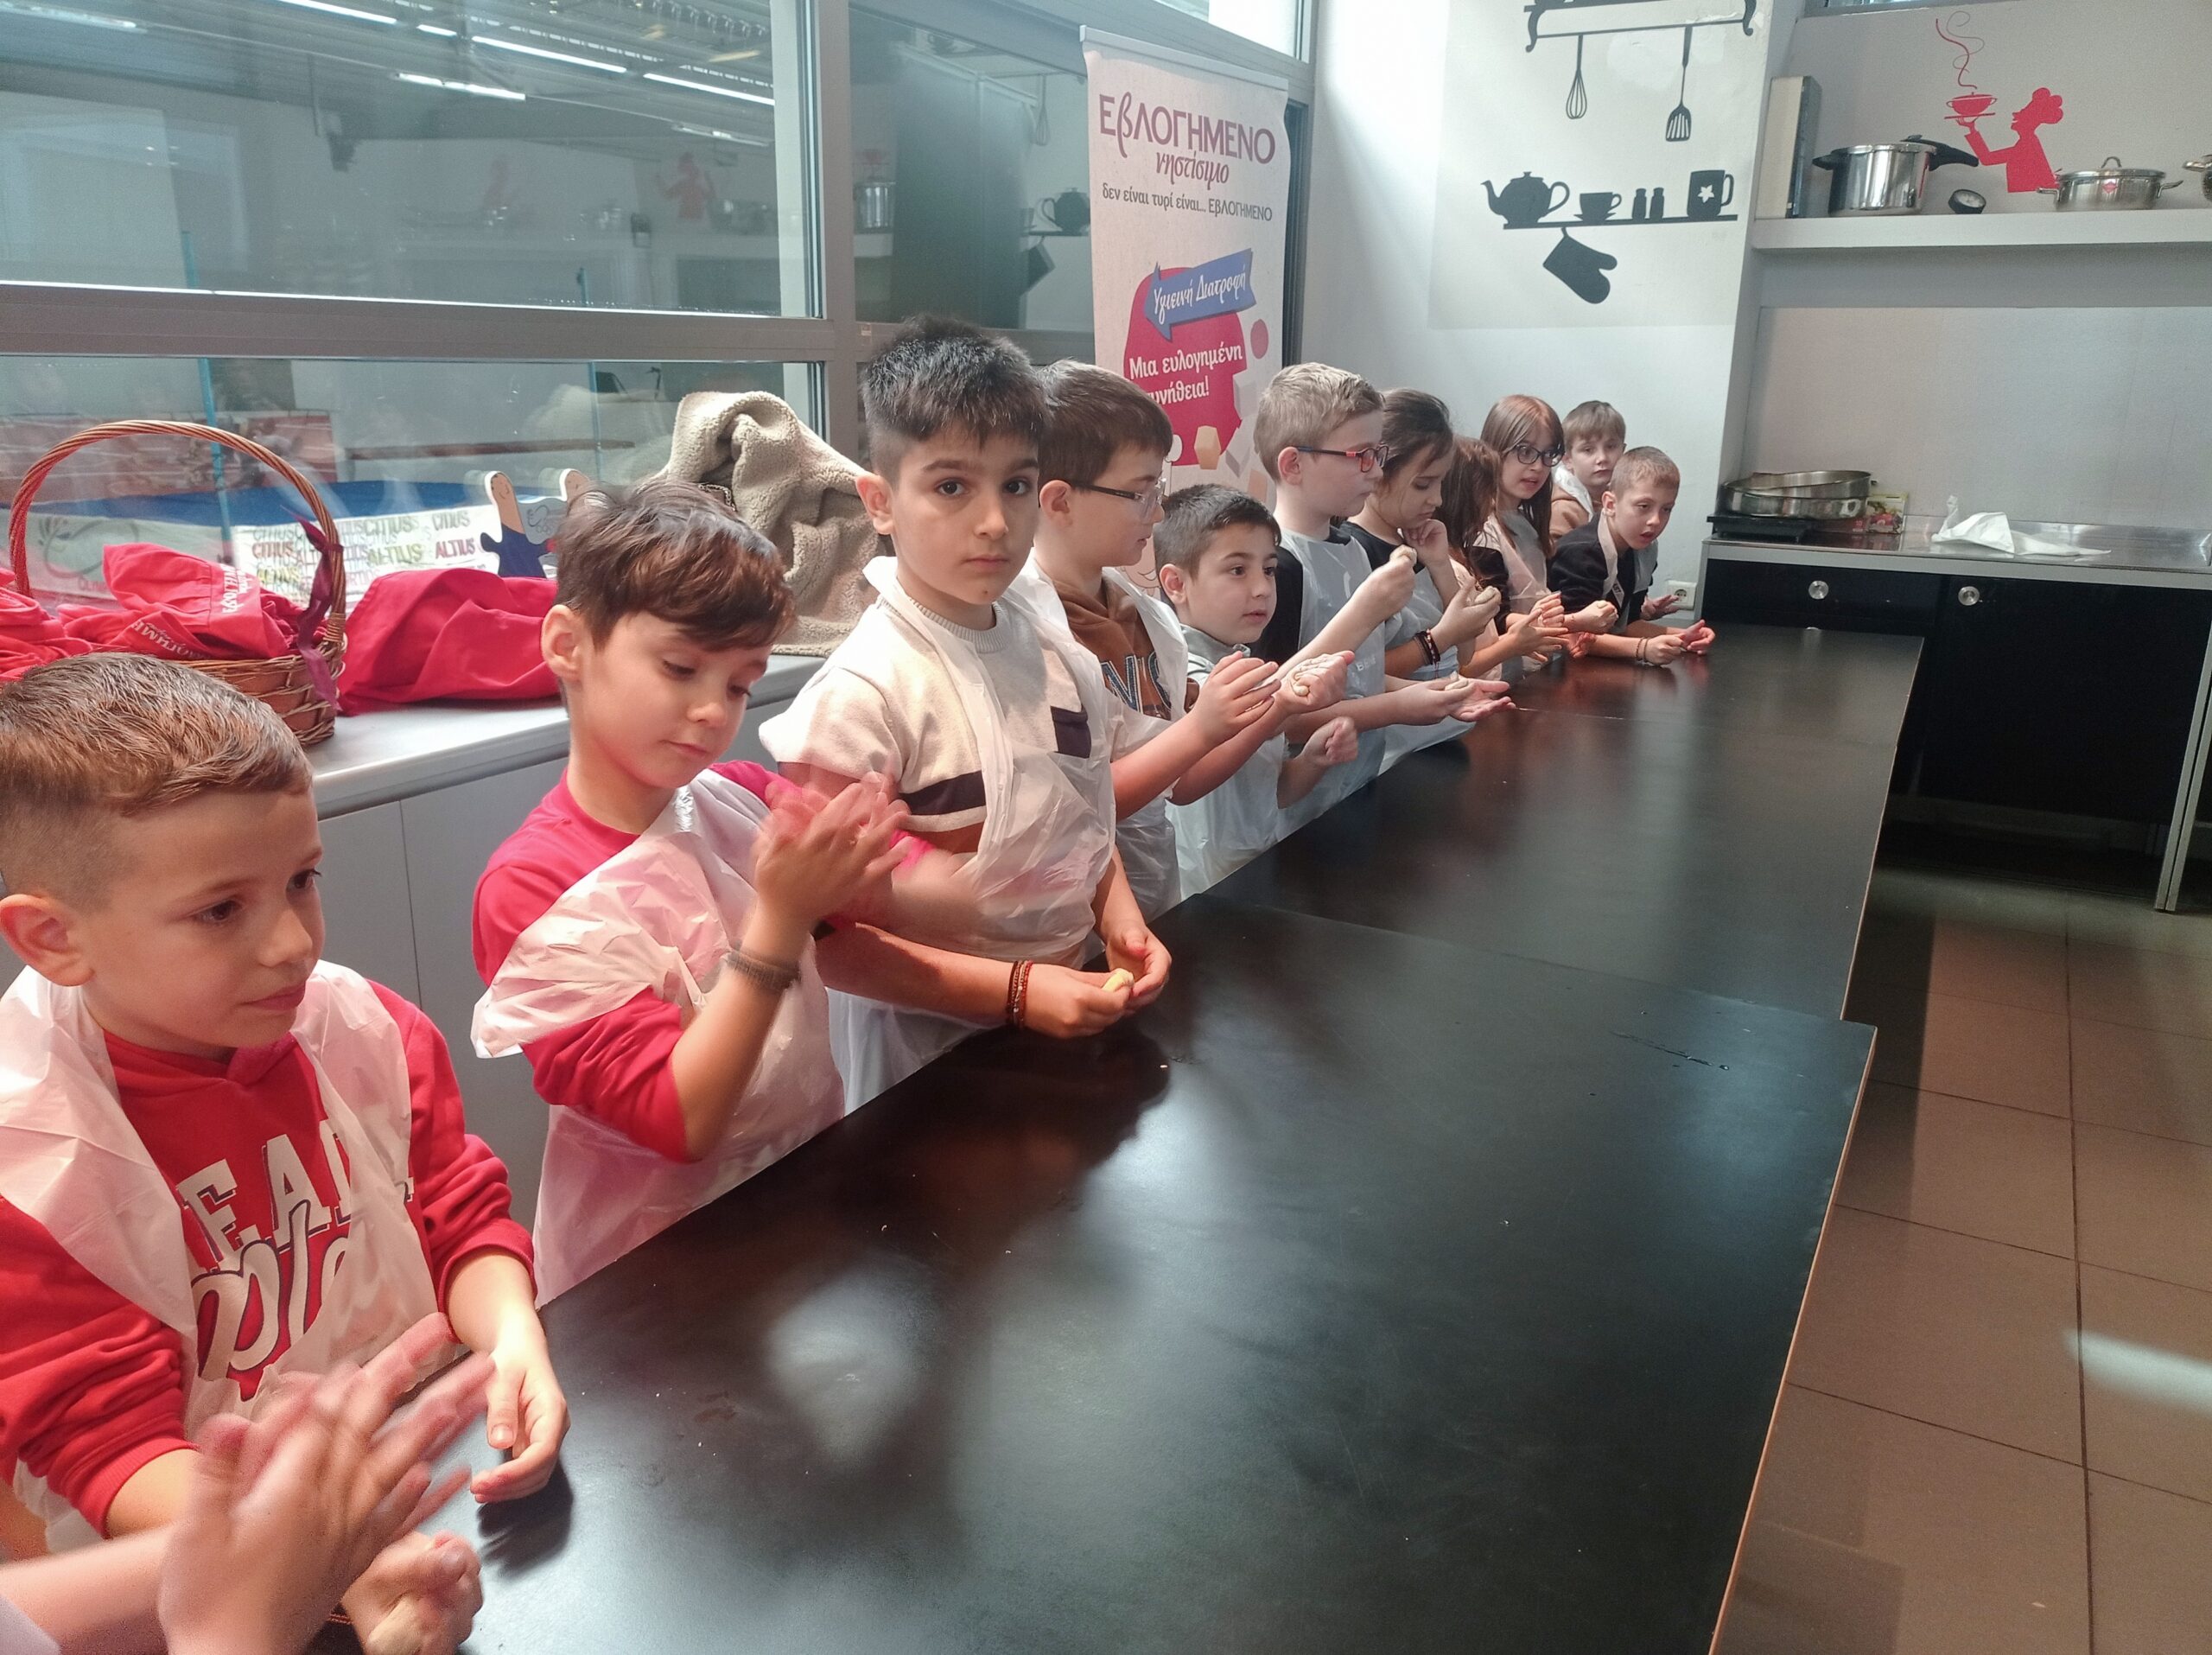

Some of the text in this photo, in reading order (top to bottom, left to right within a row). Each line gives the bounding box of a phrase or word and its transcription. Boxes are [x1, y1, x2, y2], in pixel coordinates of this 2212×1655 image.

[1103, 182, 1121, 200] δεν
[1123, 186, 1149, 205] είναι
[1152, 191, 1173, 209] τυρί
[1176, 193, 1206, 213] είναι...
[1154, 264, 1246, 325] Υγιεινή Διατροφή
[1129, 341, 1243, 380] Μια ευλογημένη
